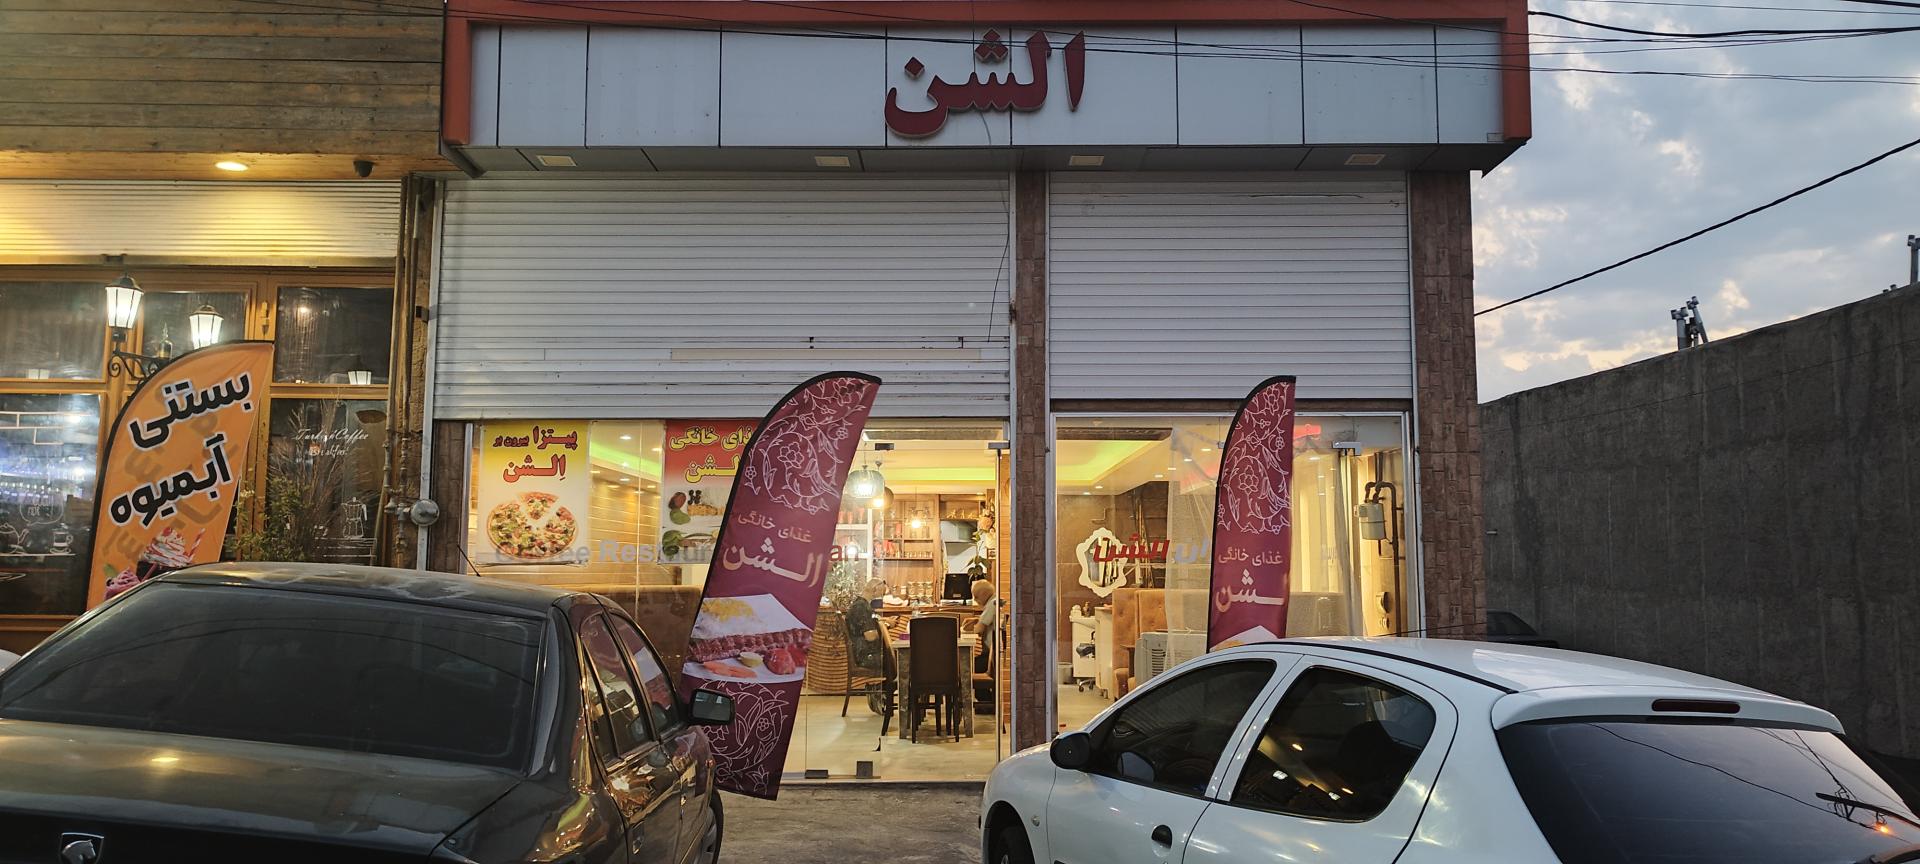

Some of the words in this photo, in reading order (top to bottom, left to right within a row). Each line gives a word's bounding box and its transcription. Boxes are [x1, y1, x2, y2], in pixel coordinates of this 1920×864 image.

[884, 28, 1086, 138] الشن
[129, 374, 253, 448] بستنی
[532, 425, 579, 451] پیتزا
[670, 427, 719, 450] خانگی
[722, 427, 753, 450] ذای
[111, 433, 231, 526] آبمیوه
[685, 454, 740, 484] لشن
[737, 510, 776, 530] خانگی
[777, 526, 812, 543] غذای
[723, 537, 823, 588] الشن
[1218, 546, 1249, 564] خانگی
[1251, 550, 1283, 567] غذای
